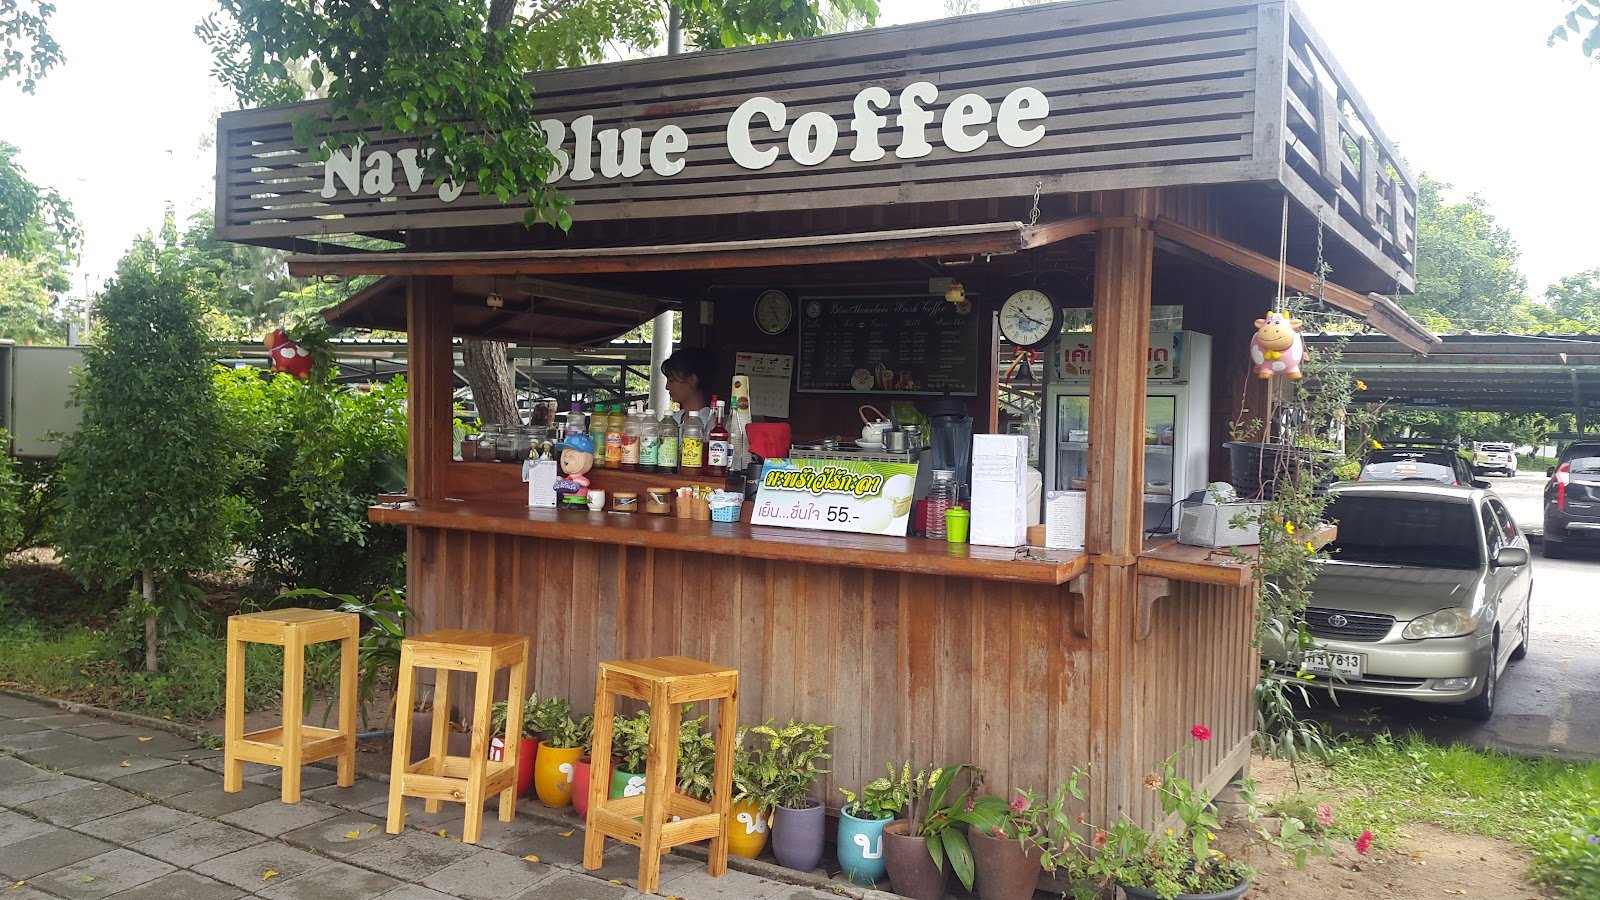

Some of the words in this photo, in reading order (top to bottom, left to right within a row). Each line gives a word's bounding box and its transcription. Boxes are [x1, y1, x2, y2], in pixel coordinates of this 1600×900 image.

[528, 114, 689, 182] Blue
[727, 82, 1050, 171] Coffee
[764, 466, 882, 496] มะพร้าวไร้กะลา
